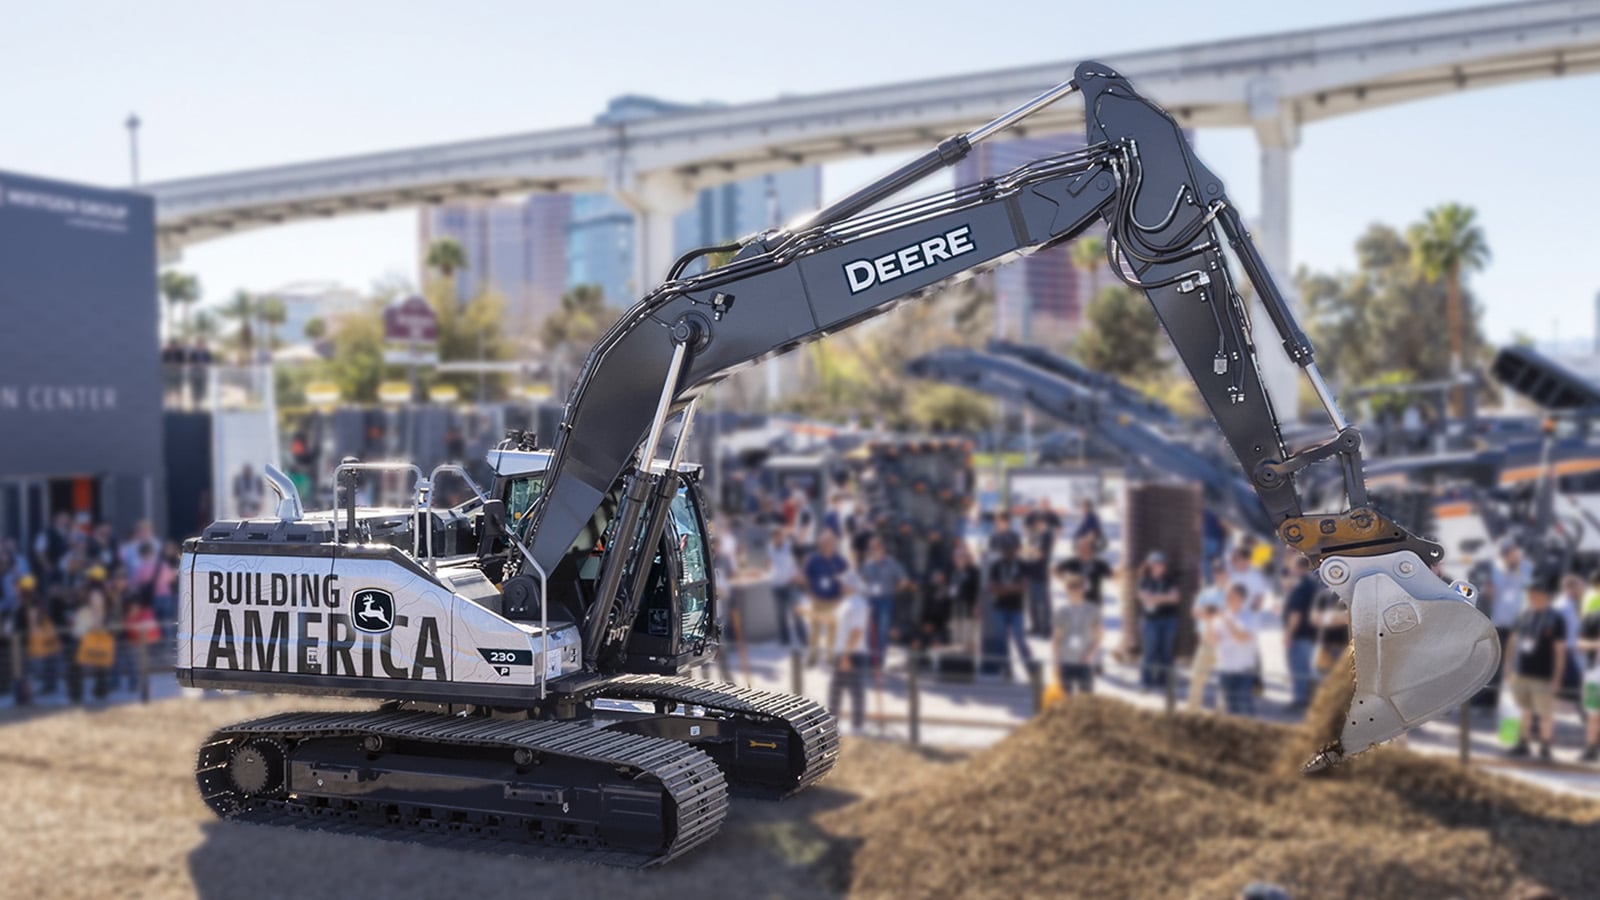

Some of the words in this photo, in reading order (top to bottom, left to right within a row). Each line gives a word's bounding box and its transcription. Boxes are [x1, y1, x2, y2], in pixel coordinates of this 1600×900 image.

[845, 227, 974, 293] DEERE
[27, 384, 118, 412] CENTER
[208, 571, 341, 609] BUILDING
[206, 608, 448, 682] AMERICA
[490, 651, 517, 662] 230
[500, 667, 510, 677] P
